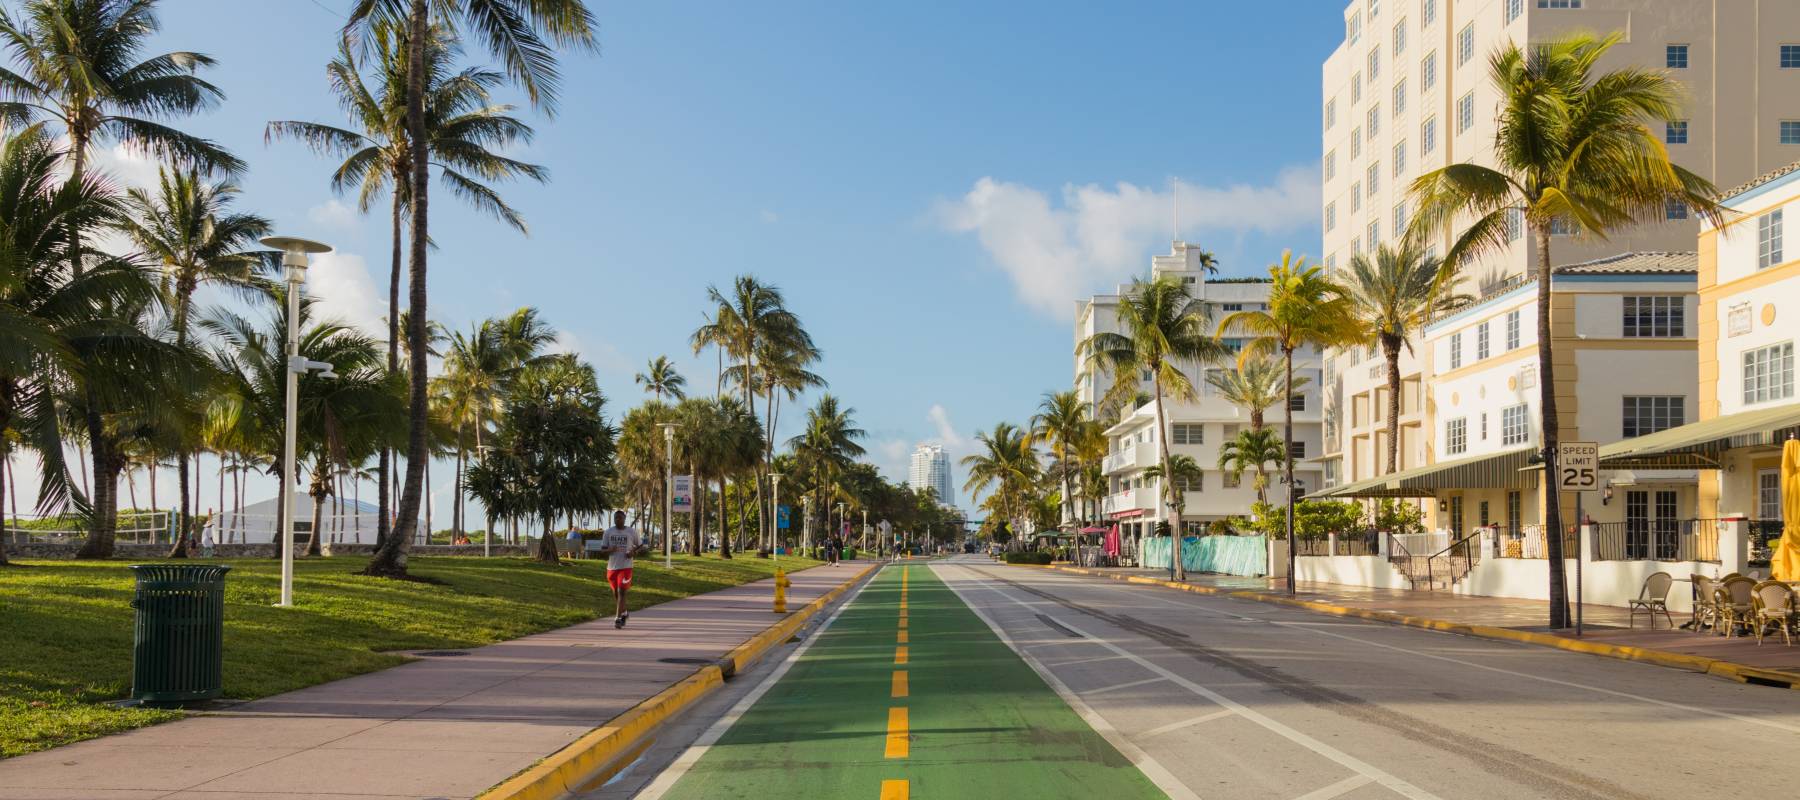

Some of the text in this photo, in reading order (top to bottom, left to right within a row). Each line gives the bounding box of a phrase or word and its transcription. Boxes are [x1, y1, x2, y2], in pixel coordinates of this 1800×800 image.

[1562, 446, 1596, 455] SPEED
[1565, 457, 1592, 465] LIMIT
[1563, 468, 1595, 486] 25
